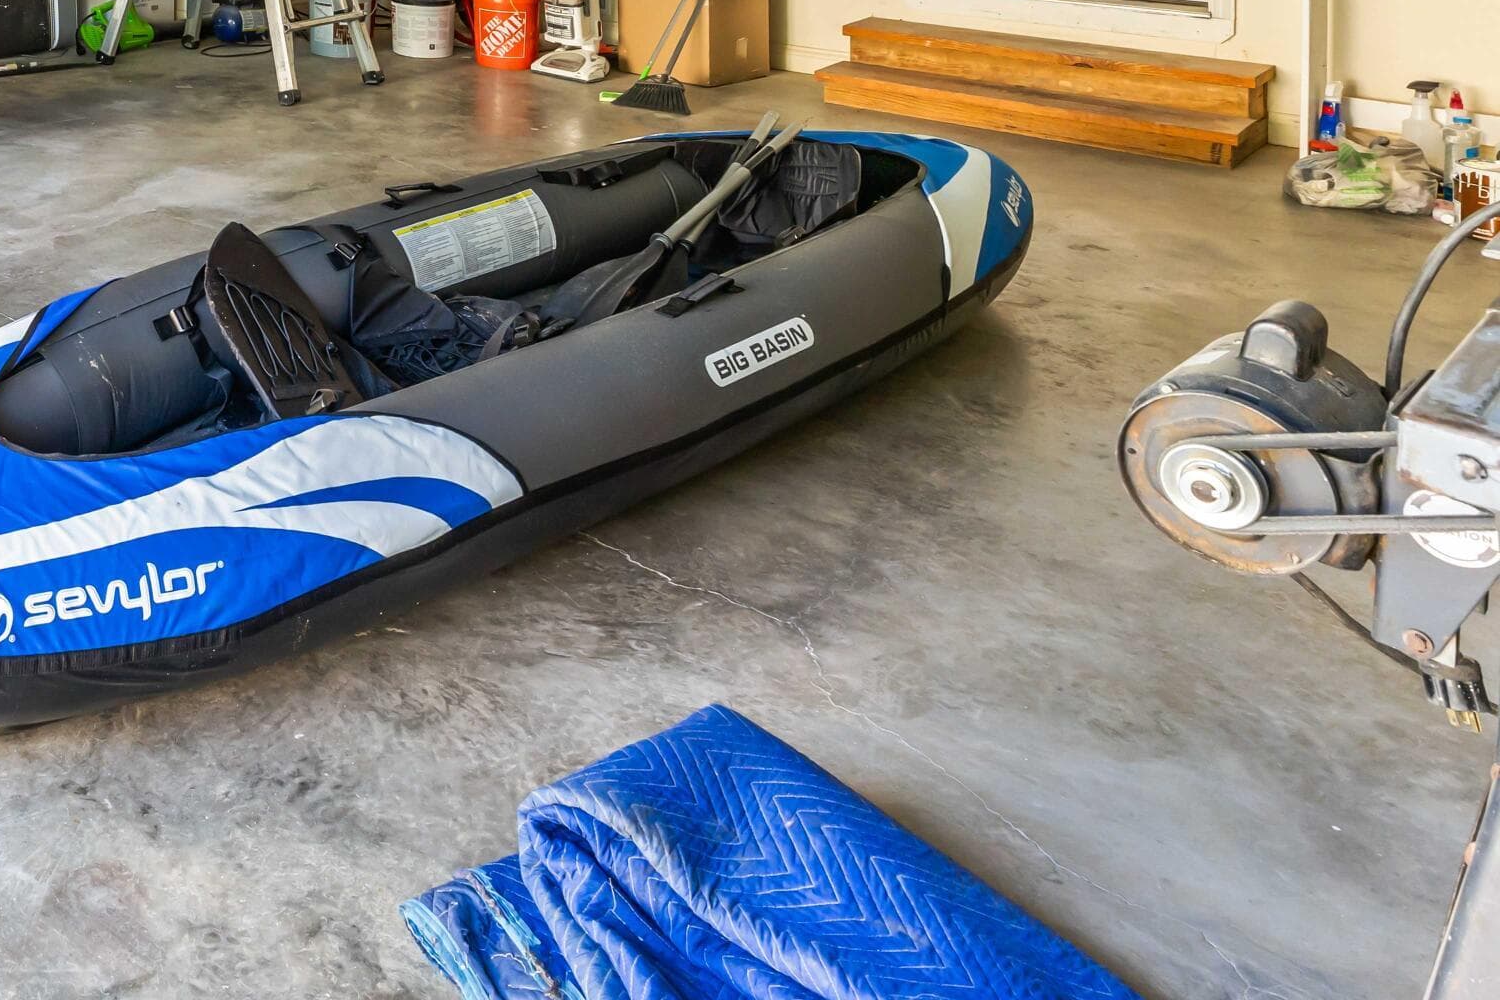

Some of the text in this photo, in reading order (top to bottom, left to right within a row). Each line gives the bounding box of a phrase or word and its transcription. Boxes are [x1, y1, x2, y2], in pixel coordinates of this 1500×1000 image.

[481, 14, 526, 55] HOME
[484, 15, 502, 33] THE
[496, 29, 525, 57] DEPOT
[713, 324, 808, 379] BIG BASIN
[23, 561, 217, 628] sevylor
